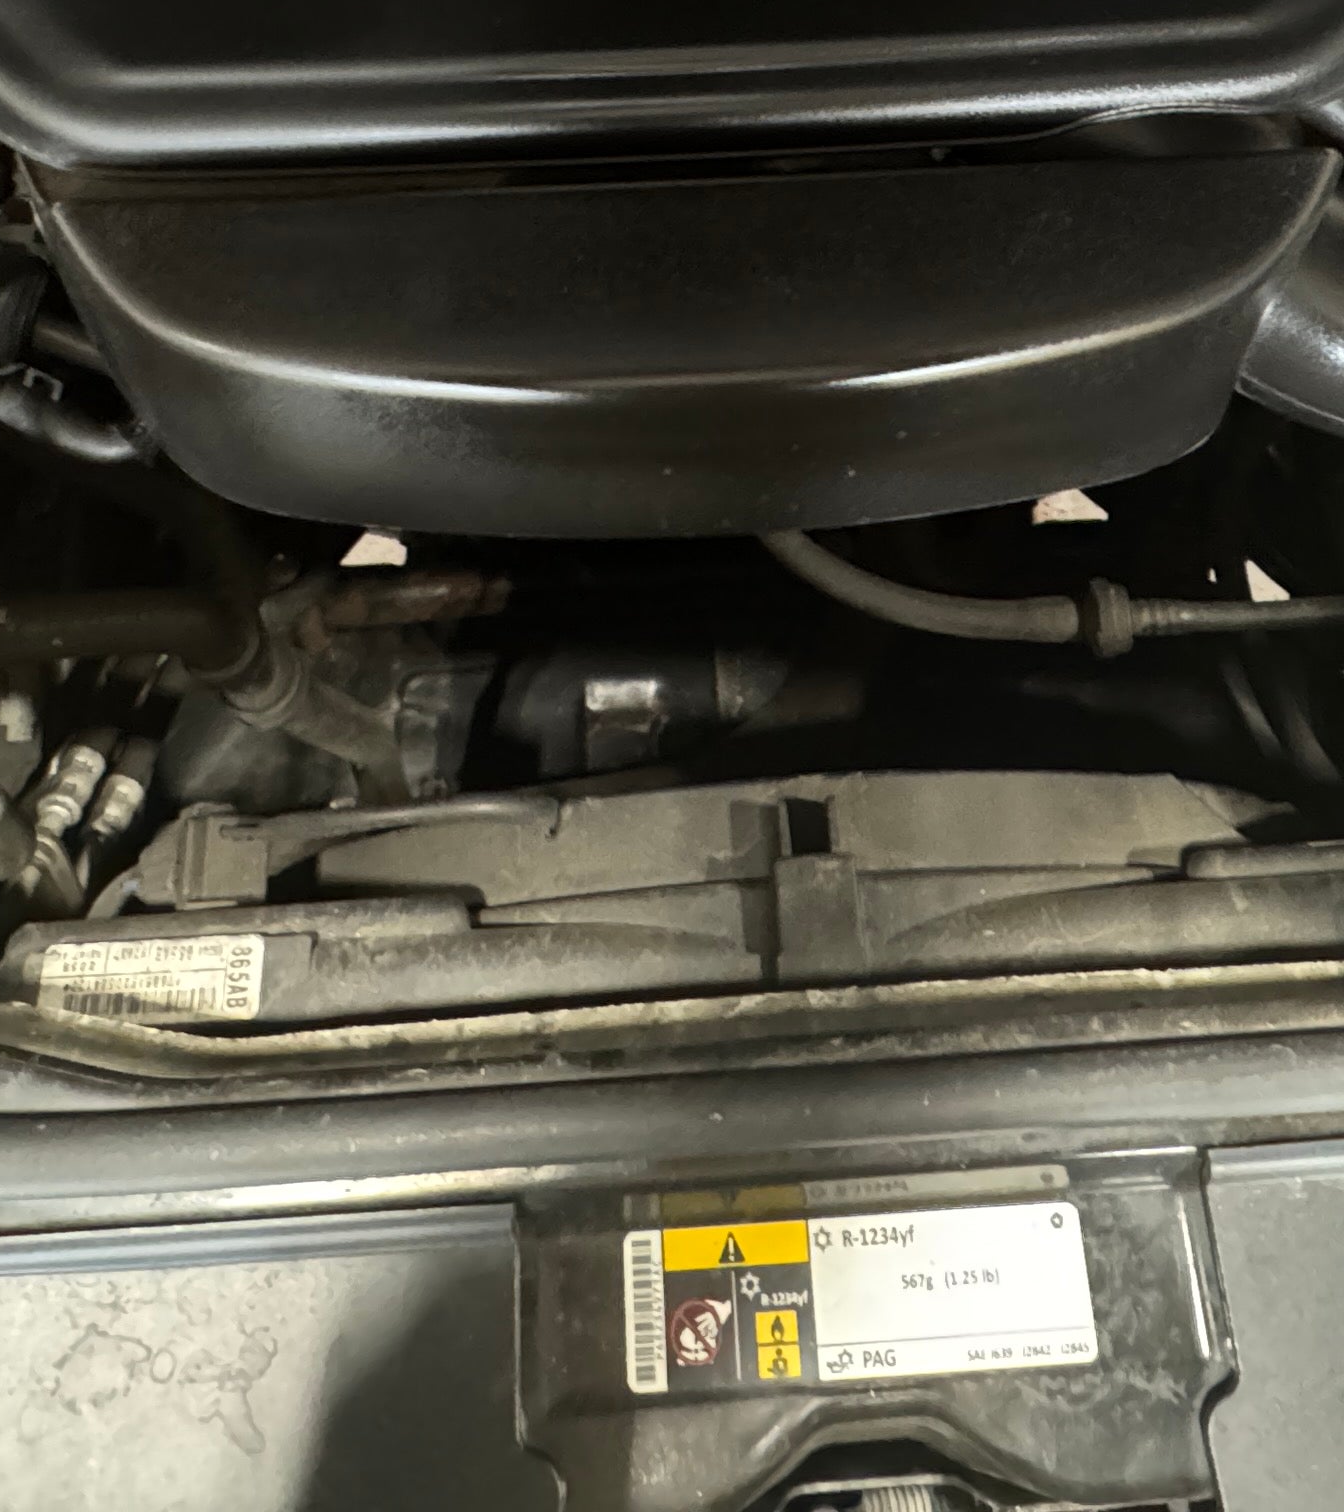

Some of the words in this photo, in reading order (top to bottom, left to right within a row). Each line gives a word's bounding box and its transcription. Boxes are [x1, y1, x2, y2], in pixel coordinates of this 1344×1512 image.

[842, 1225, 914, 1248] R-1234yf
[902, 1273, 933, 1290] 567g
[863, 1349, 896, 1368] PAG
